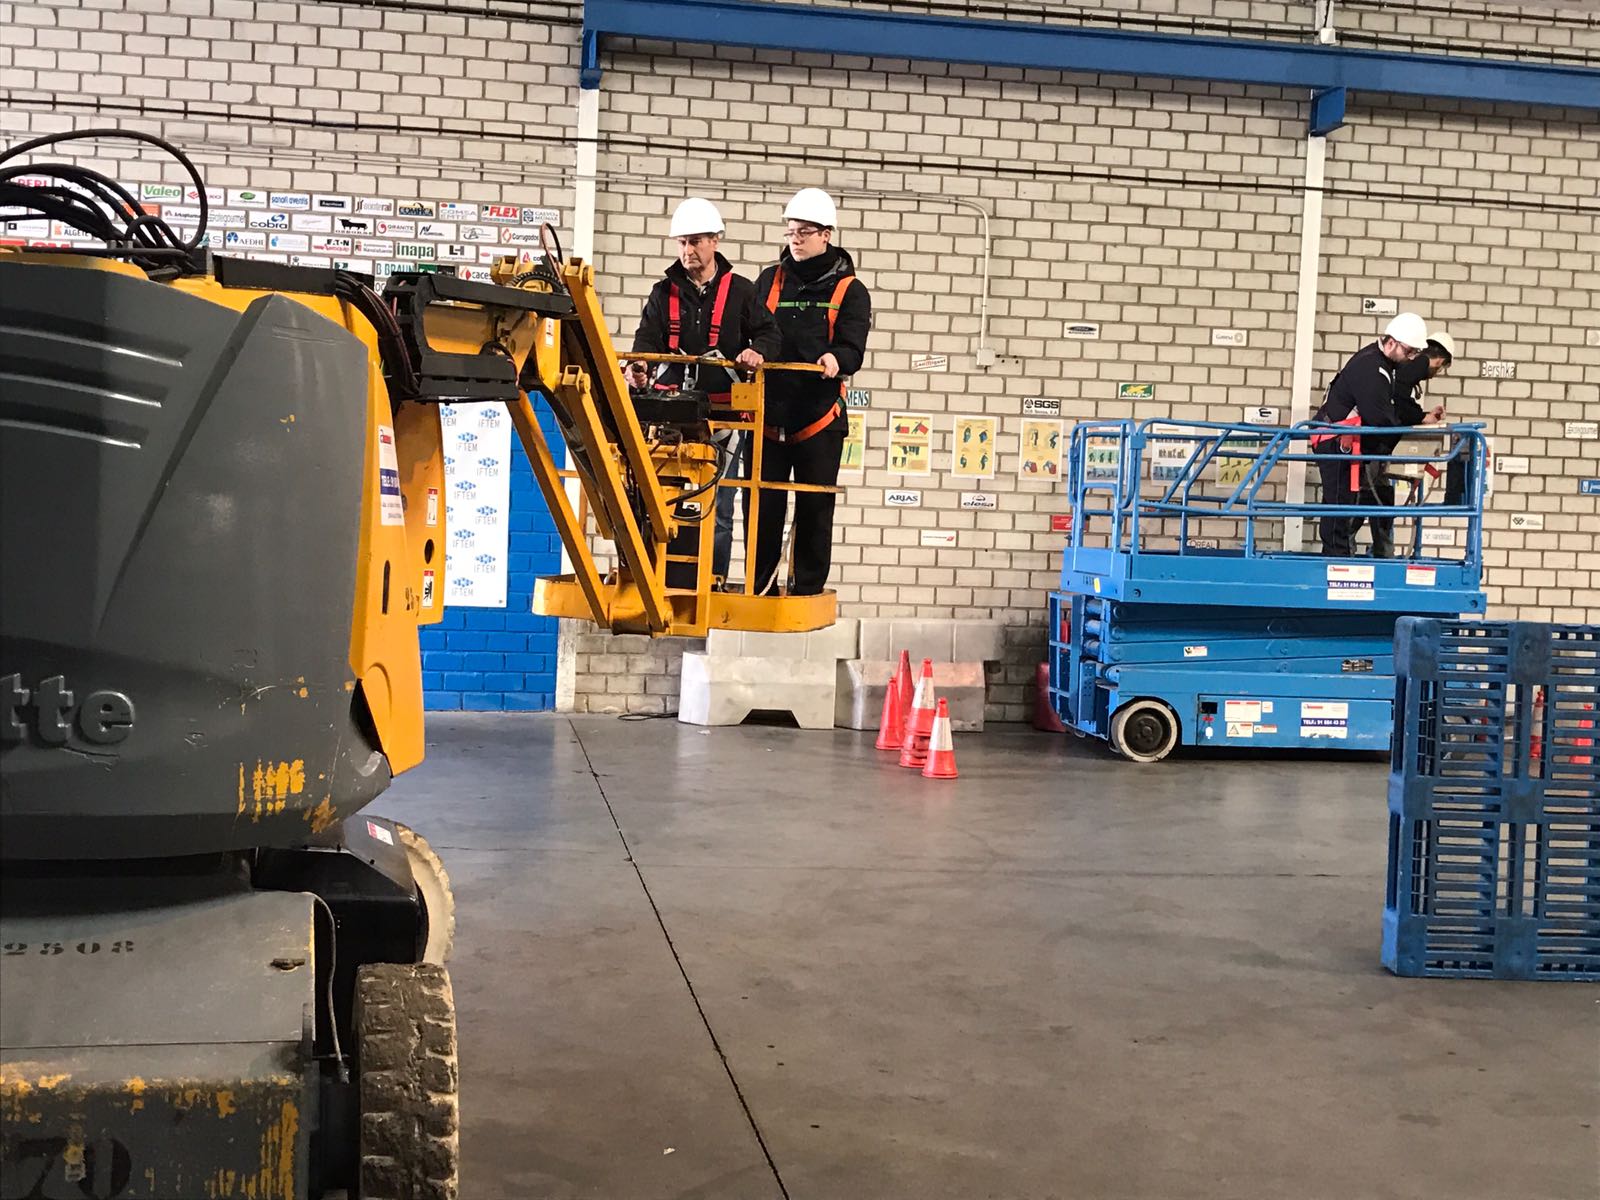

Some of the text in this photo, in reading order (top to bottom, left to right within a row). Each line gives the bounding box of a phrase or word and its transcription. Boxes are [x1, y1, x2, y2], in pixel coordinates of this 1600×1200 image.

[144, 185, 180, 197] Valeo
[271, 196, 288, 205] sanofi
[489, 206, 518, 218] FLEX
[250, 219, 288, 229] cobra
[512, 233, 539, 242] Corrugados
[396, 242, 434, 259] inapa
[472, 270, 490, 280] cace
[1481, 360, 1515, 378] Bershka
[847, 390, 869, 406] MENS
[1034, 400, 1059, 409] SGS
[443, 417, 457, 426] TEM
[478, 419, 500, 428] IFTEM
[456, 443, 478, 451] IFTEM
[477, 468, 498, 477] IFTEM
[454, 491, 476, 500] IFTEM
[475, 516, 497, 525] IFTEM
[453, 539, 475, 548] IFTEM
[474, 564, 496, 573] IFTEM
[452, 587, 473, 596] IFTEM
